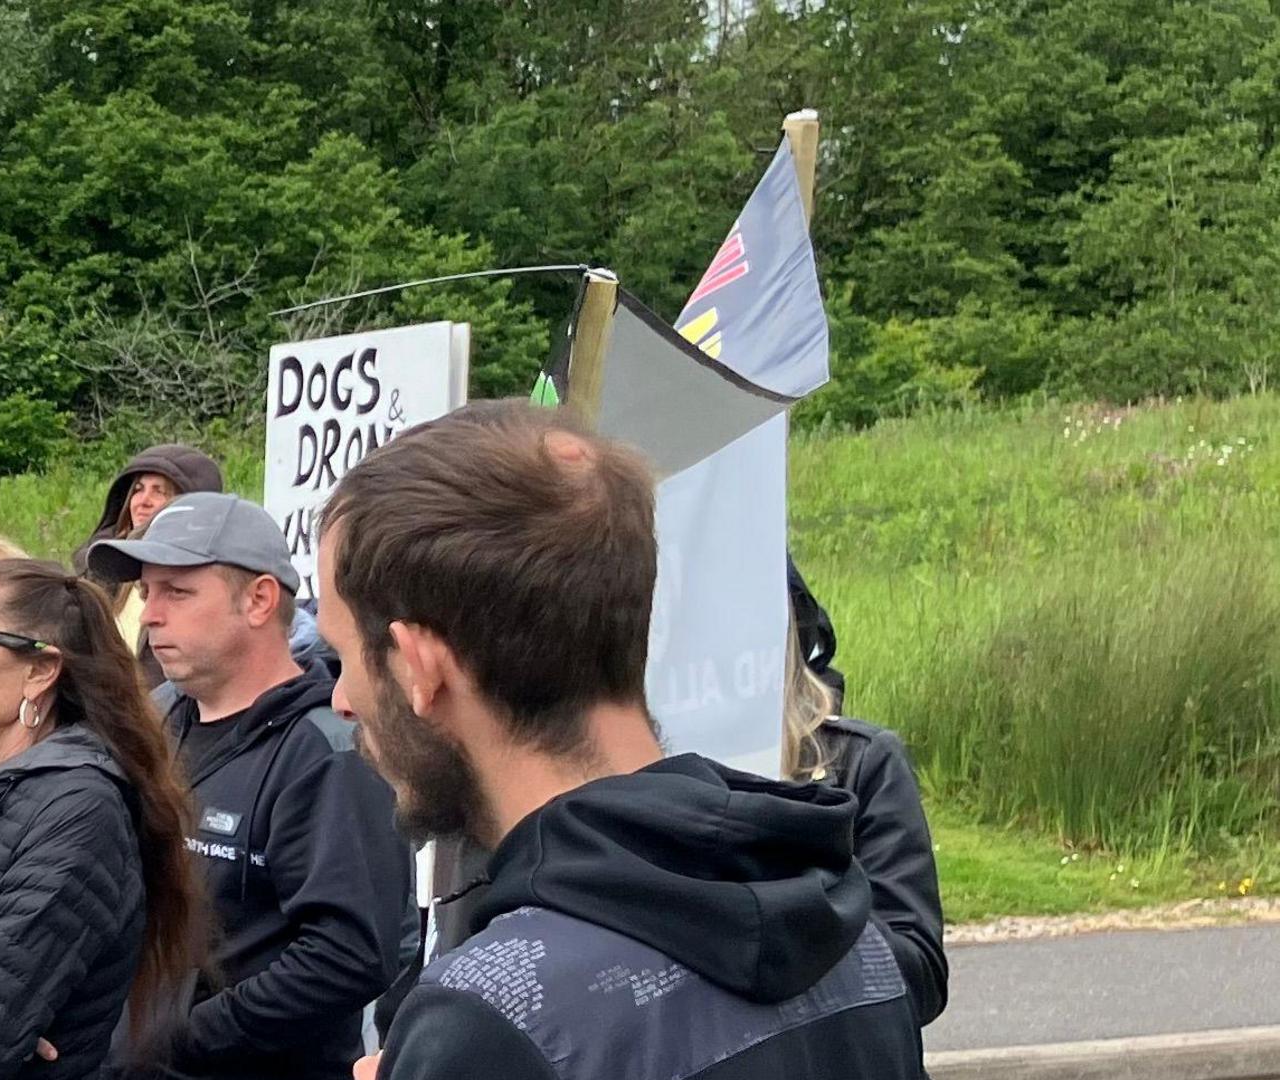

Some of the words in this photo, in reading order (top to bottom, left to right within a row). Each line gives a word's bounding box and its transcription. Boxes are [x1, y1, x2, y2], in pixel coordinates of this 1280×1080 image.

[275, 348, 381, 419] DOGS
[388, 388, 406, 424] &
[248, 852, 266, 867] HE
